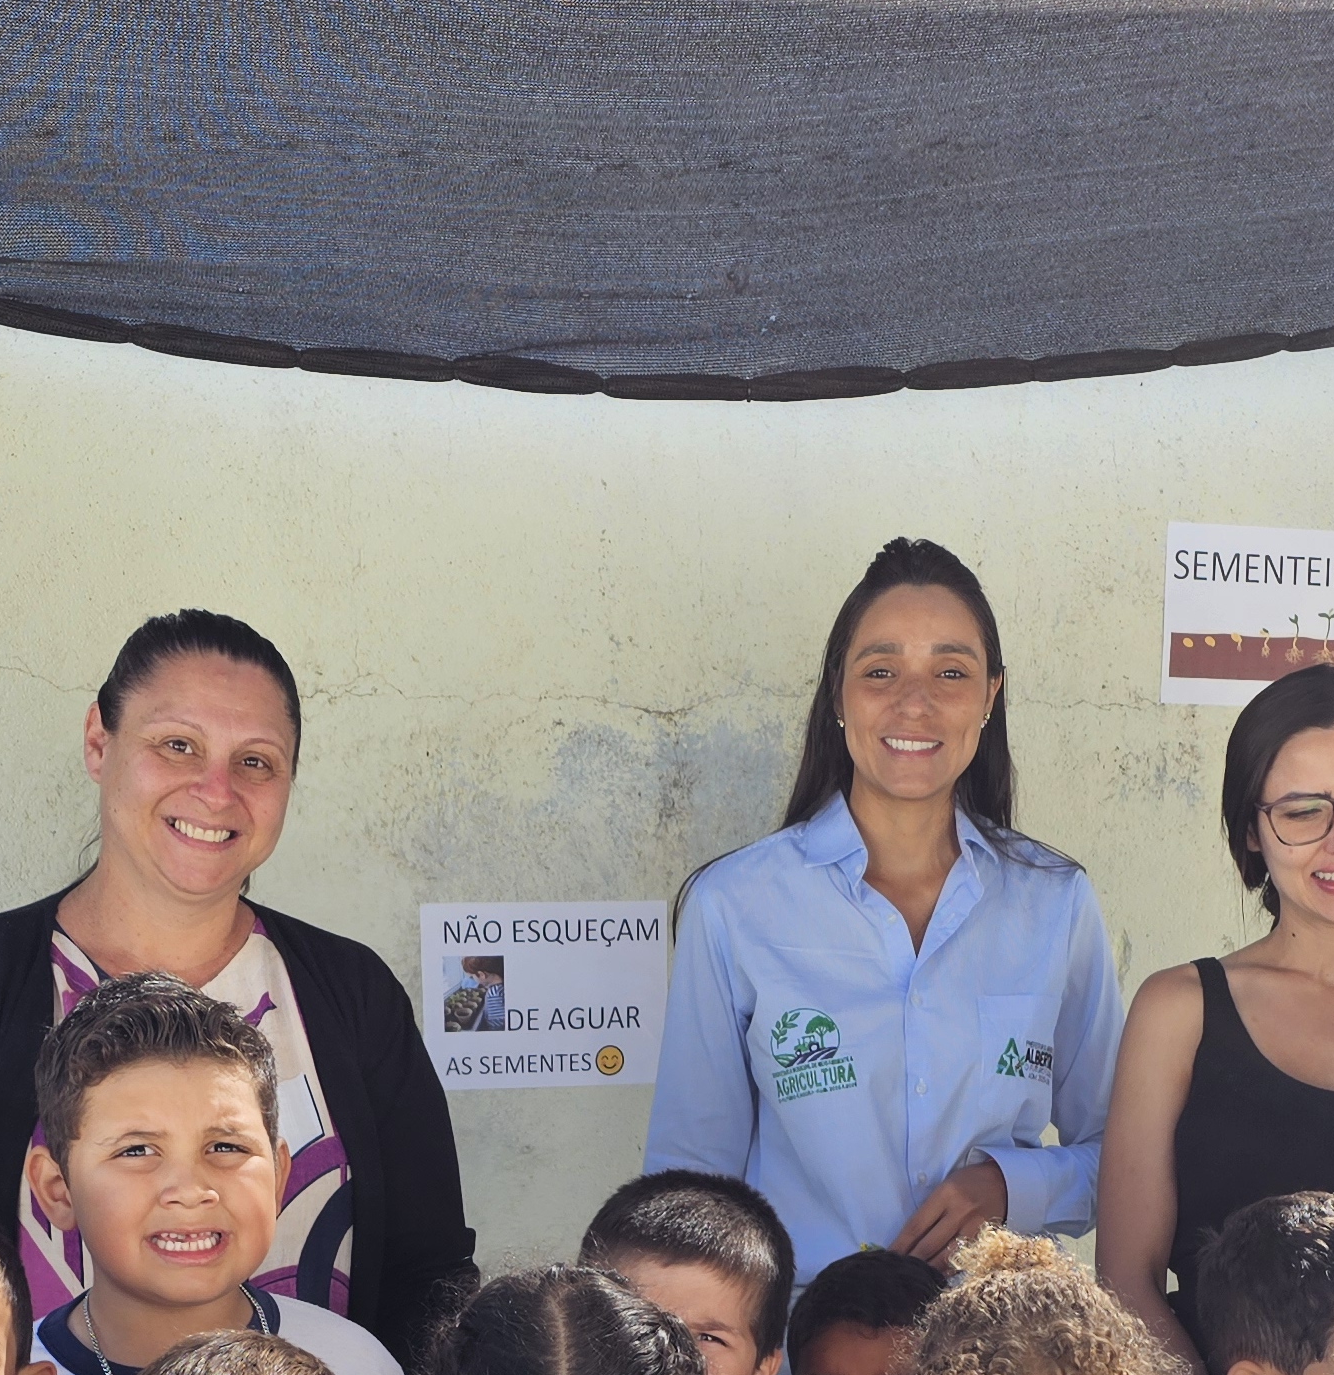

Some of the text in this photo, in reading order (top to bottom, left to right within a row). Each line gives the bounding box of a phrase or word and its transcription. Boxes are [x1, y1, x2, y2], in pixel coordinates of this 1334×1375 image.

[443, 914, 660, 947] NÃO ESQUEÇAM
[507, 1006, 641, 1031] DE AGUAR
[445, 1052, 592, 1076] AS SEMENTES
[776, 1062, 857, 1098] AGRICULTURA
